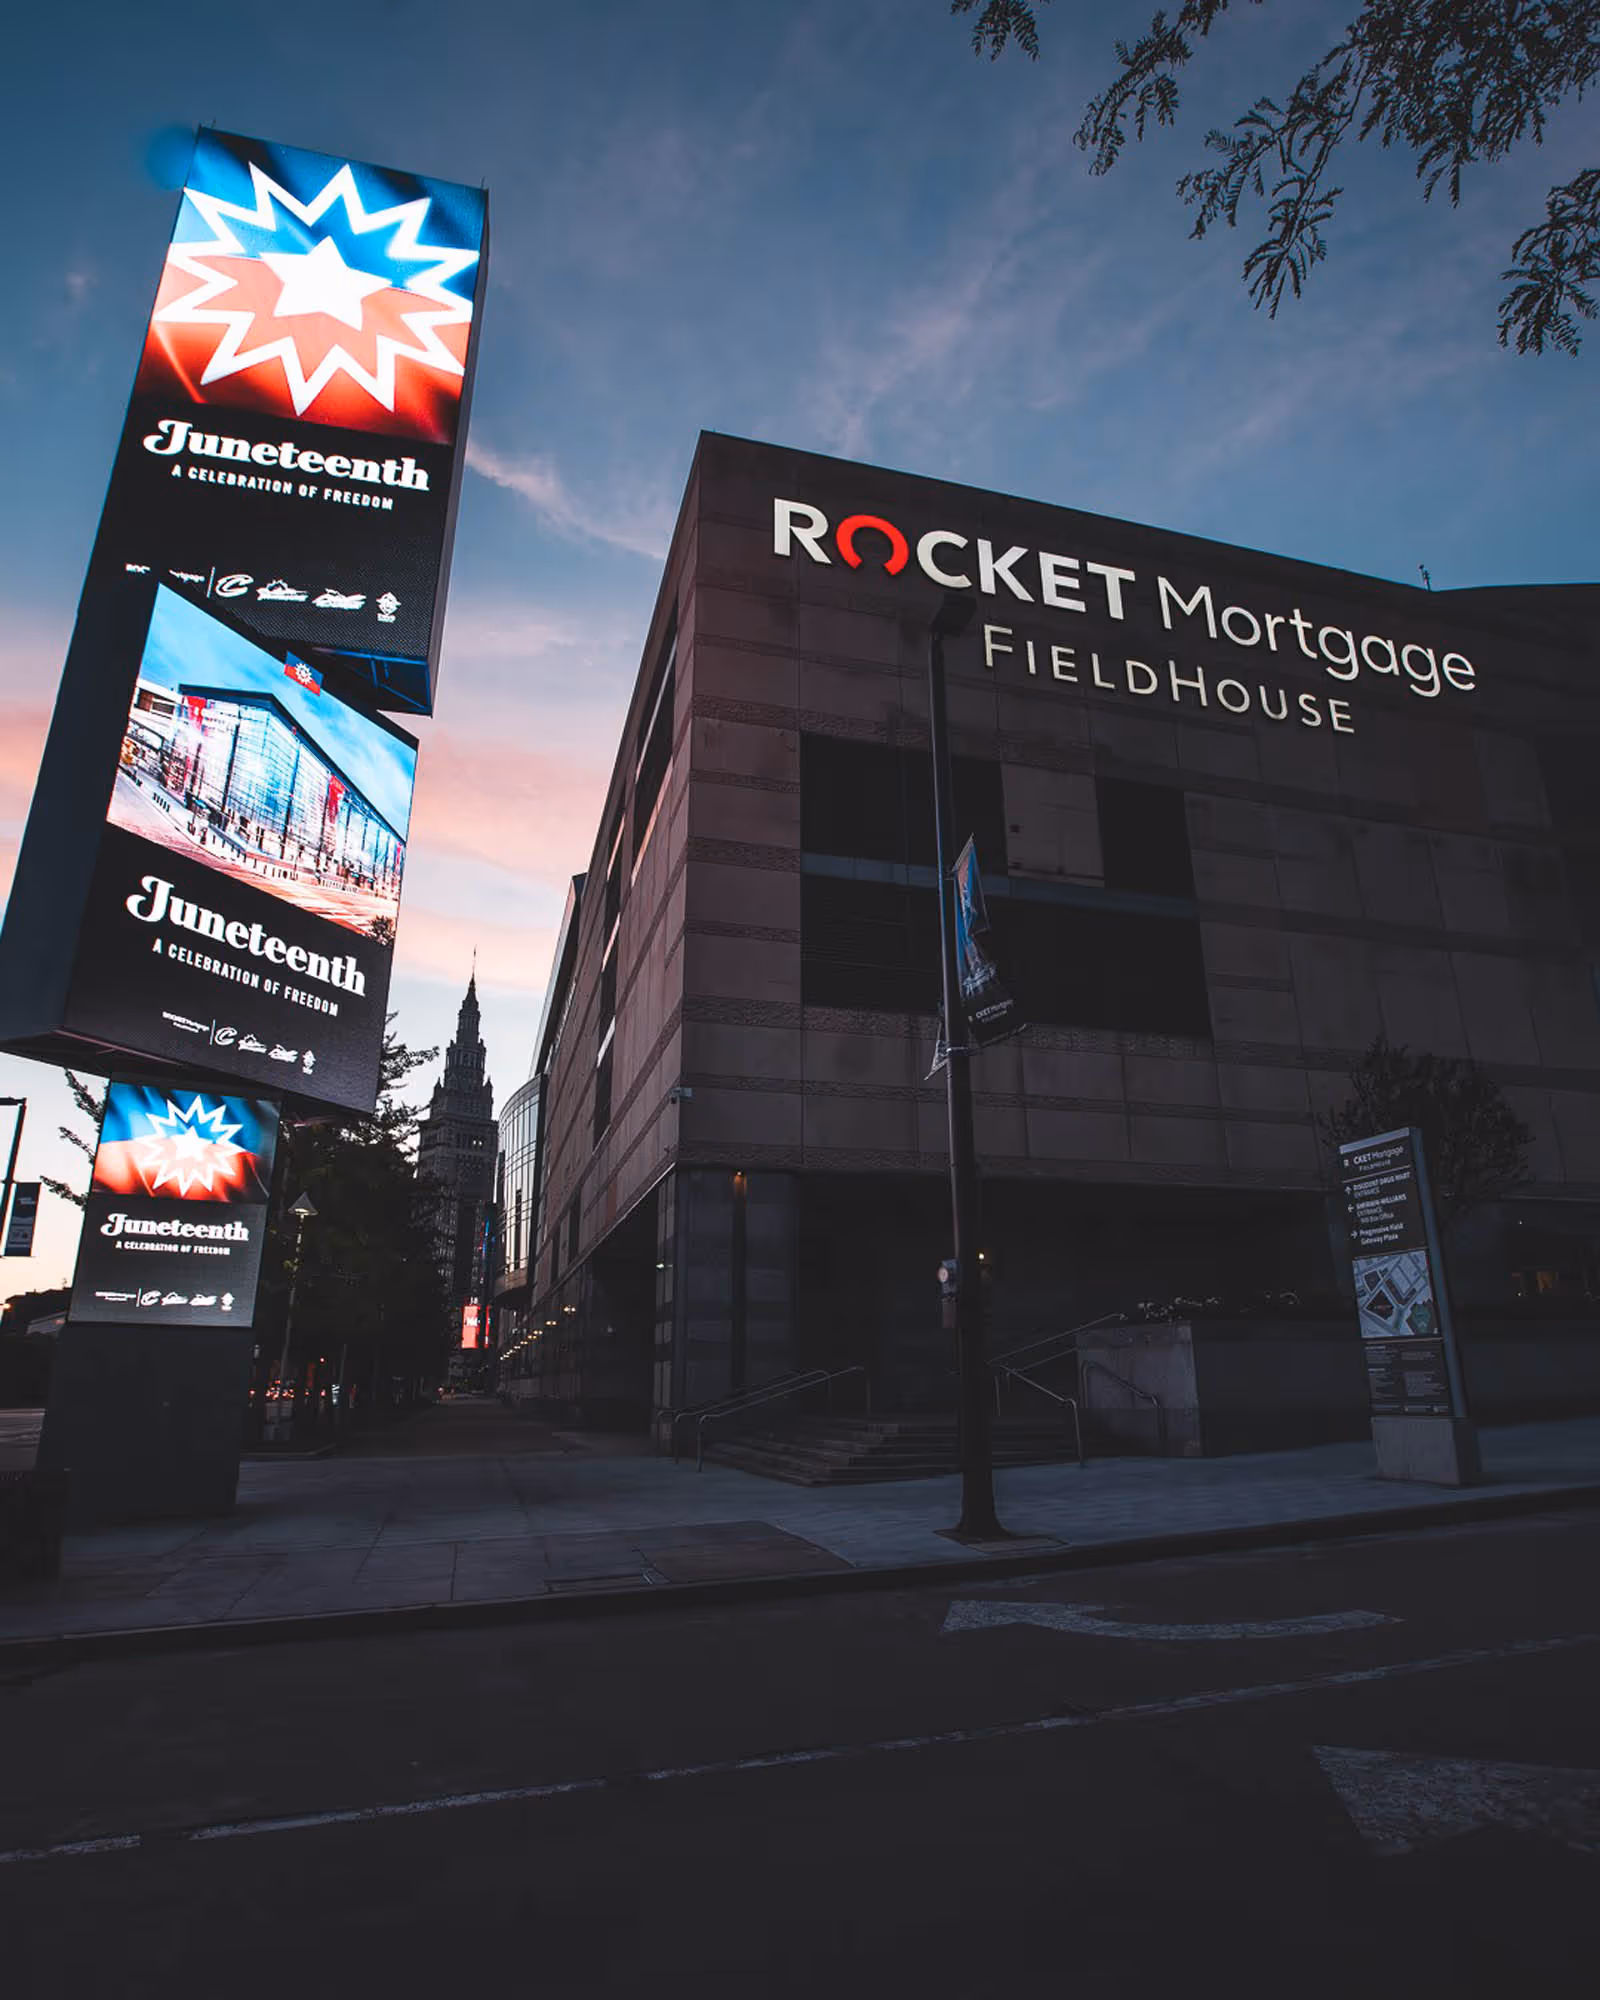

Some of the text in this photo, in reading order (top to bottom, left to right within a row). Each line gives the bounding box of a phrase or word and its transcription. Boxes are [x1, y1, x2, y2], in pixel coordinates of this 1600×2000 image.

[143, 418, 430, 492] Juneteenth
[171, 464, 394, 510] A CELEBRATION OF FREEDOM
[773, 497, 1477, 698] ROCKET Mortgage
[984, 624, 1355, 734] FIELDHOUSE
[126, 875, 366, 997] Juneteenth
[152, 938, 339, 1017] A CELEBRATION OF FREEDOM
[100, 1213, 249, 1241] Juneteenth
[115, 1241, 231, 1255] A CELEBRATION OF FREEDOM
